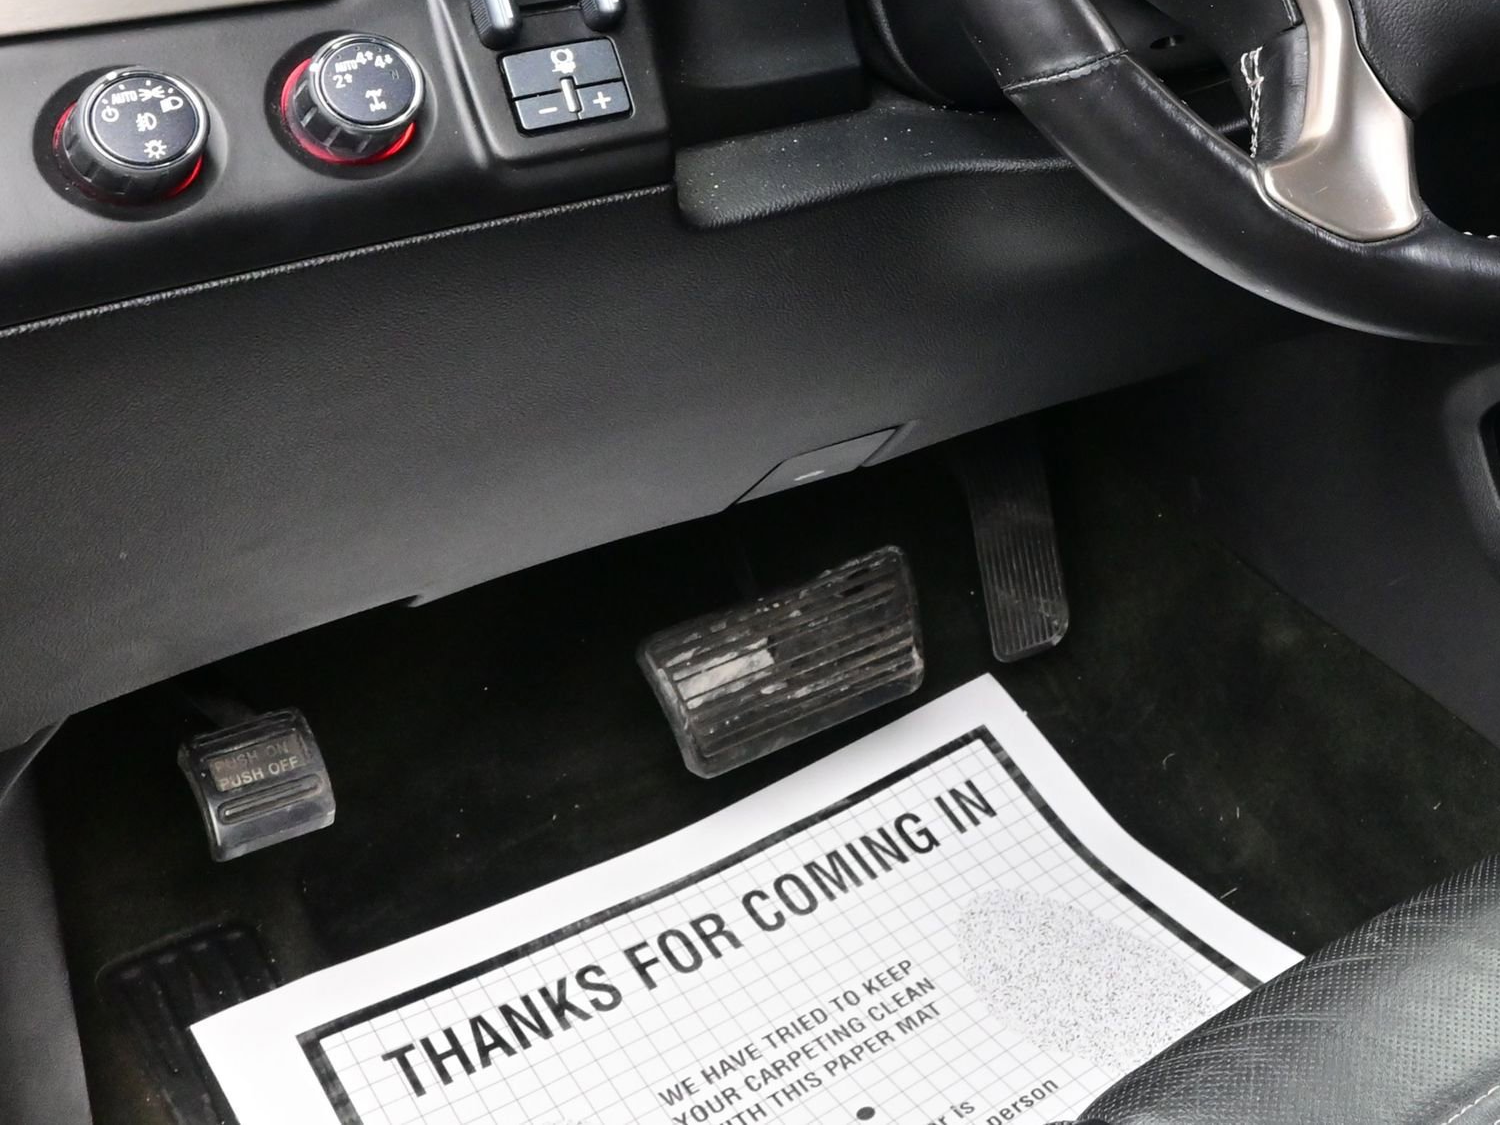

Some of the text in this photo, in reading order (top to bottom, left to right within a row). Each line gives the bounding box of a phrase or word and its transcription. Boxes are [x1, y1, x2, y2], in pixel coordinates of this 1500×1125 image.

[334, 59, 358, 73] AUTO
[111, 90, 138, 105] AUTO
[214, 740, 290, 772] PUSH ON
[219, 756, 299, 791] PUSH OFF
[381, 778, 999, 1098] THANKS FOR COMING IN
[658, 958, 913, 1106] WE HAVE TRIED TO KEEP
[672, 977, 937, 1125] YOUR CARPETING CLEAN
[766, 1071, 823, 1108] THIS
[823, 1030, 896, 1077] PAPER
[896, 999, 942, 1036] MAT
[949, 1101, 976, 1119] is
[986, 1079, 1059, 1125] person
